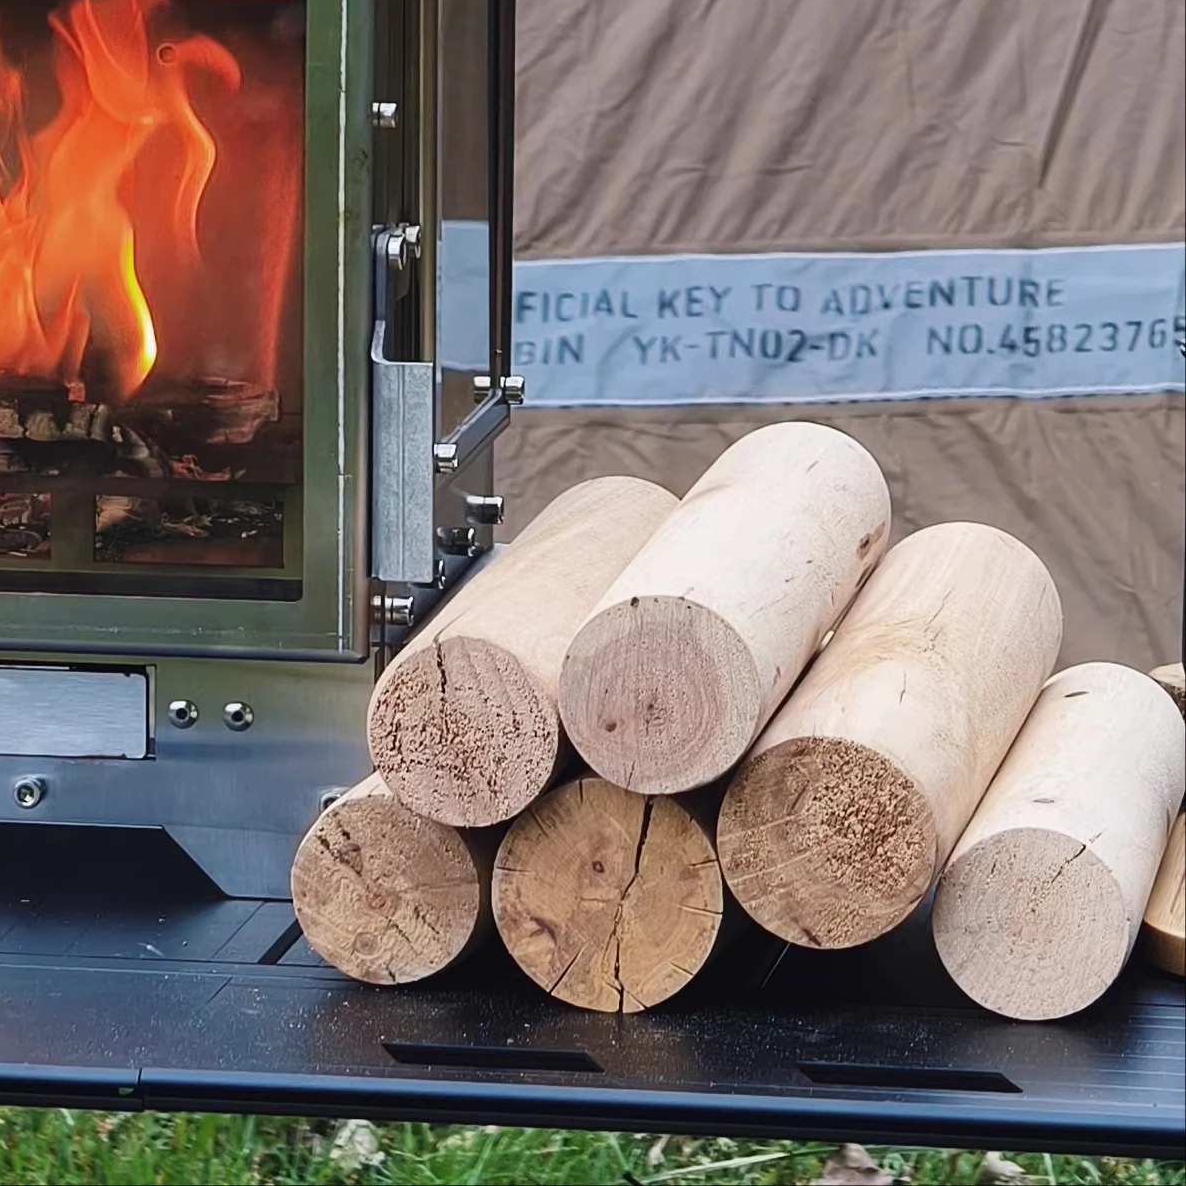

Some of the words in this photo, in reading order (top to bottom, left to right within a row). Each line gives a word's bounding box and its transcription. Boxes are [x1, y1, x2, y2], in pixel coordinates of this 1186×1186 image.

[515, 290, 638, 323] FICIAL
[657, 286, 732, 319] KEY
[749, 283, 802, 312] TO
[820, 276, 1065, 316] ADVENTURE
